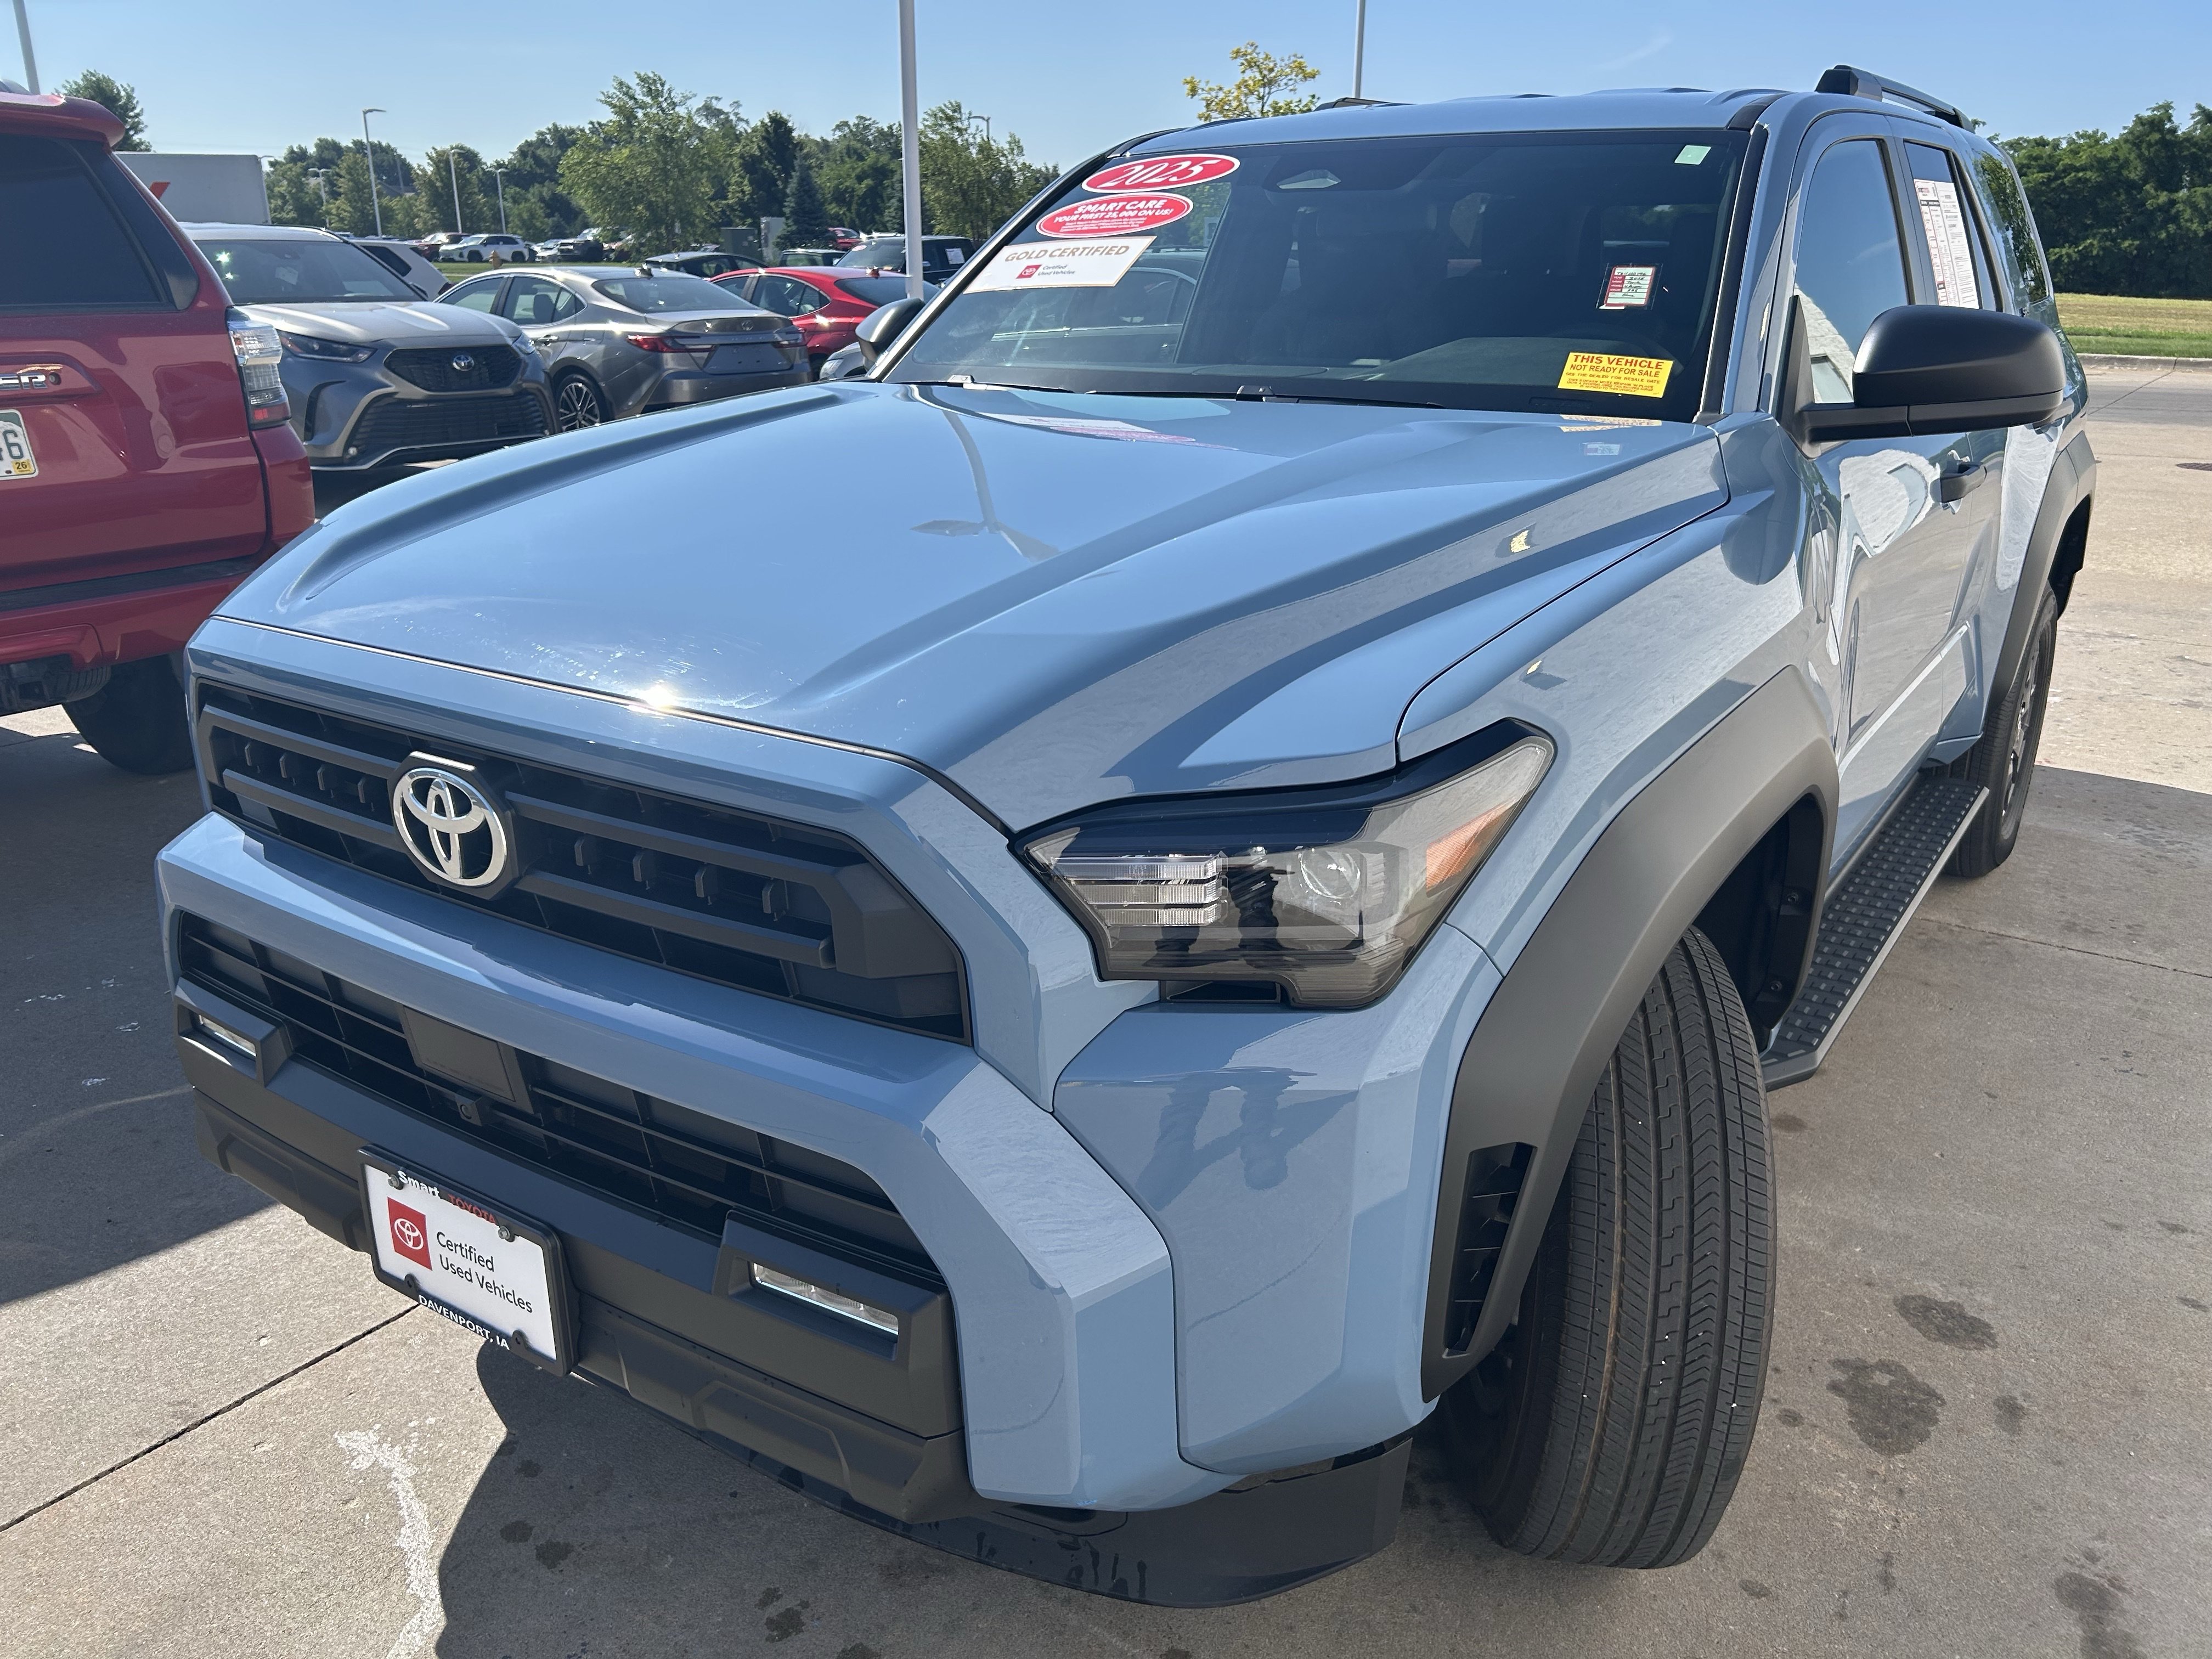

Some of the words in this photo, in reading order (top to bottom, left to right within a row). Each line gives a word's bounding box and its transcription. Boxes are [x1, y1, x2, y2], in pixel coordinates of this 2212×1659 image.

[1097, 160, 1220, 188] 2025
[1074, 202, 1127, 214] SMART
[1125, 200, 1167, 210] CARE
[1005, 250, 1048, 262] GOLD
[1048, 246, 1130, 258] CERTIFIED
[1574, 355, 1602, 364] THIS
[1607, 357, 1664, 369] VEHICLE
[15, 461, 27, 470] 26
[398, 1171, 439, 1197] Smart
[448, 1194, 496, 1224] TOYOTA
[436, 1232, 494, 1272] Certified
[439, 1254, 473, 1283] Used
[476, 1272, 532, 1313] Vehicles
[419, 1295, 493, 1342] DAVENPORT,
[496, 1335, 510, 1350] IA
